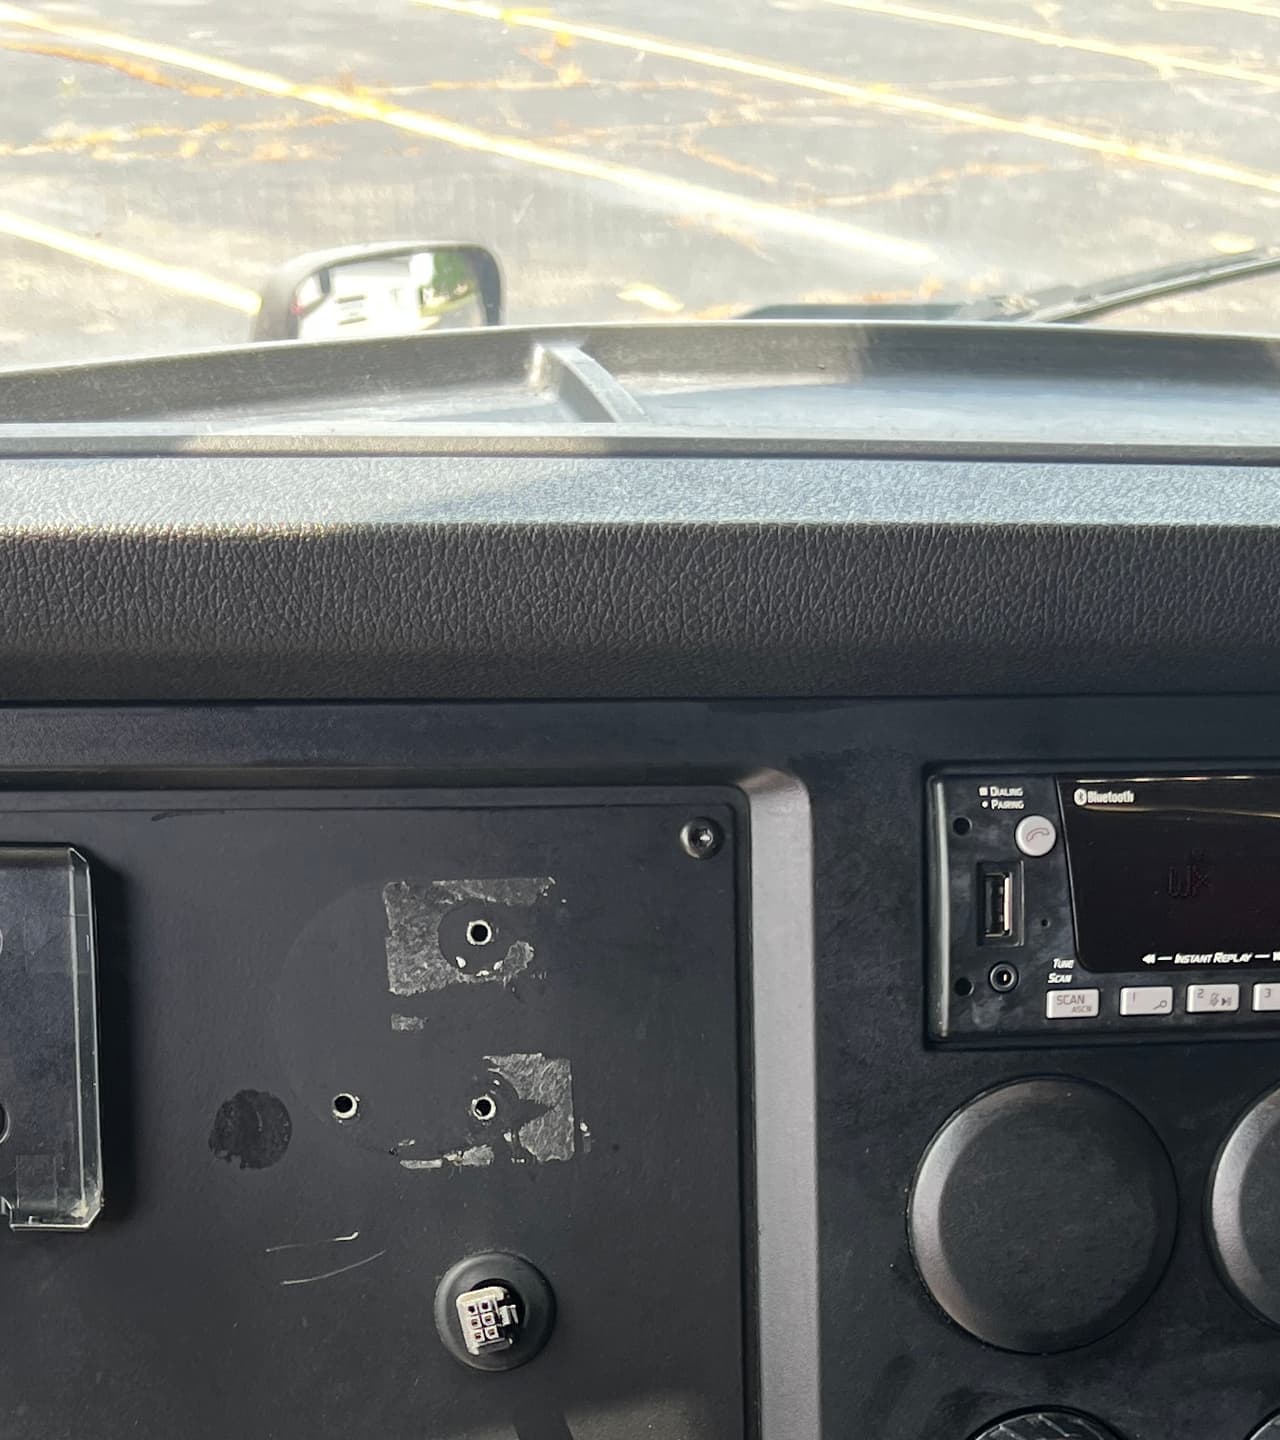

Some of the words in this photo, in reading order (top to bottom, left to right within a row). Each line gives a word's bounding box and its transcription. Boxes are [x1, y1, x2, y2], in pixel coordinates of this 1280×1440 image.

[1087, 790, 1135, 804] Bluetooth
[1196, 988, 1205, 999] 2
[1264, 987, 1272, 999] 3
[1056, 994, 1086, 1006] SCAN
